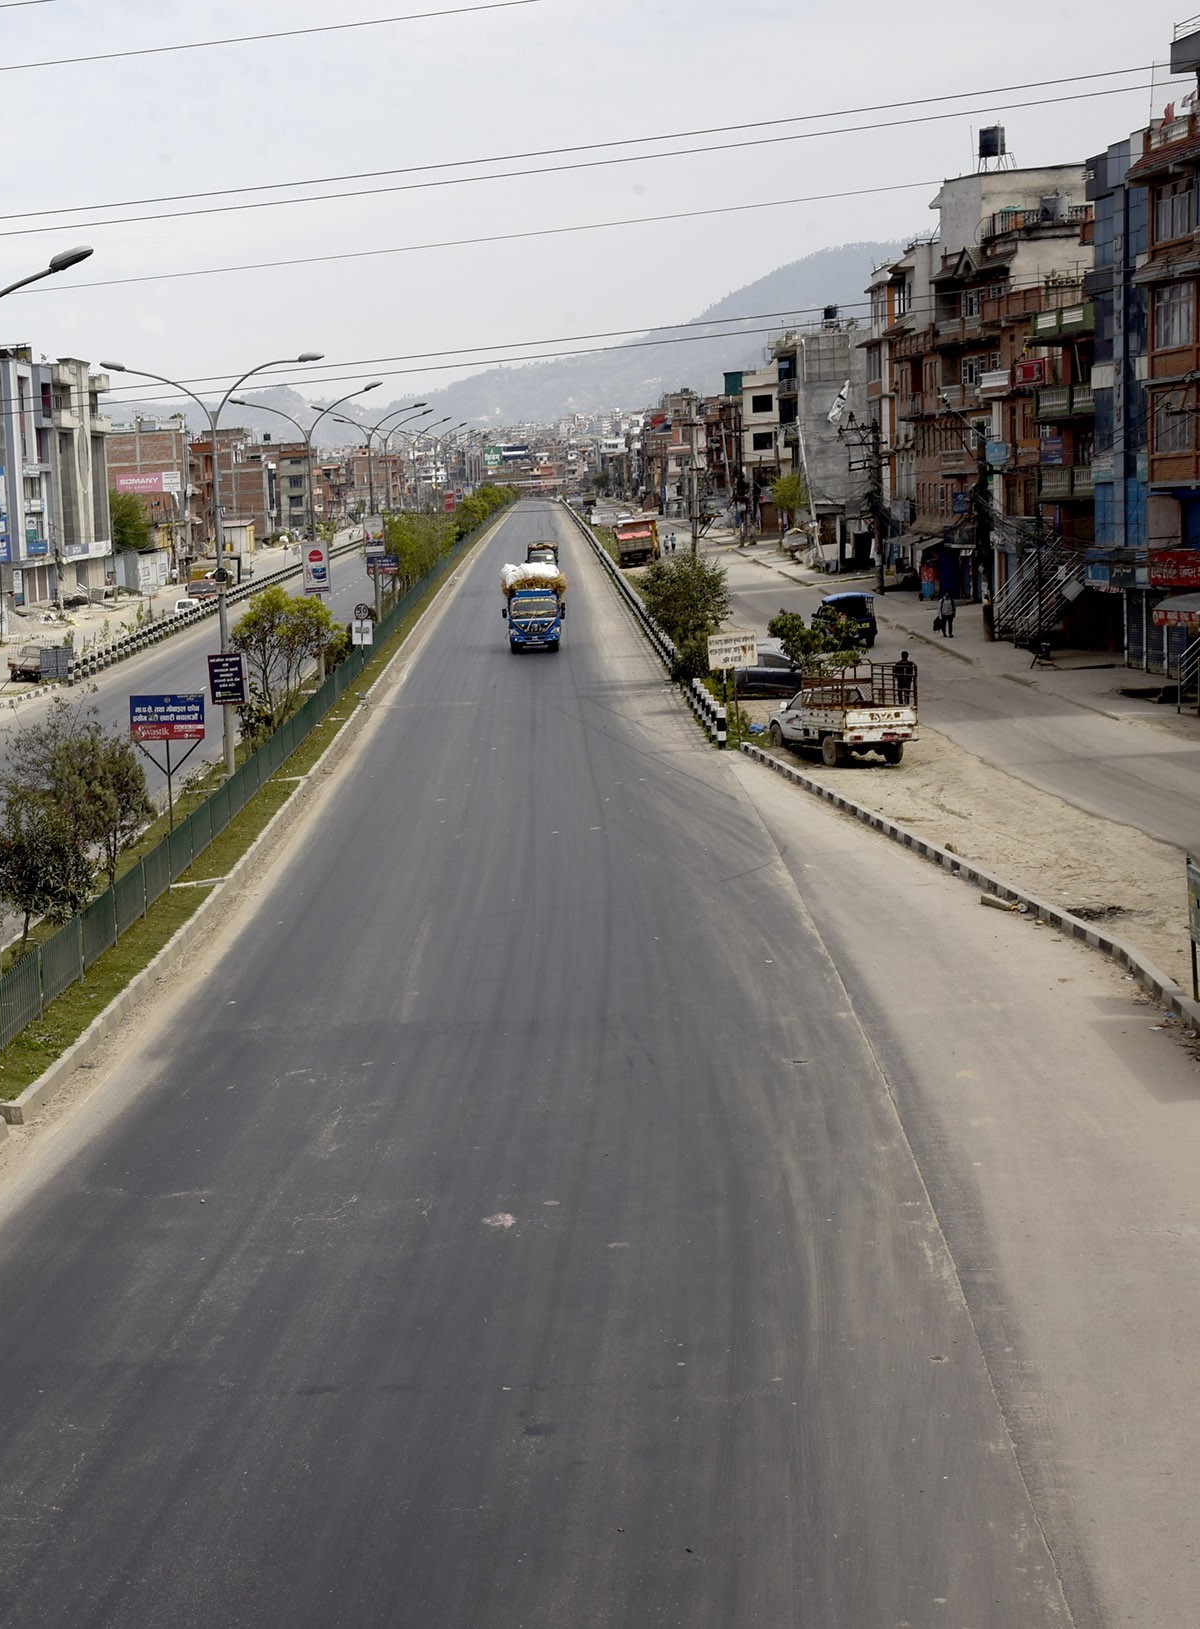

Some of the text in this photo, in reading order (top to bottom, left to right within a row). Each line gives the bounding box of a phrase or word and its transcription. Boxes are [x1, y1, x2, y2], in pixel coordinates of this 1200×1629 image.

[119, 477, 159, 485] SOMANY
[356, 606, 368, 614] 50
[138, 725, 170, 737] Swastik
